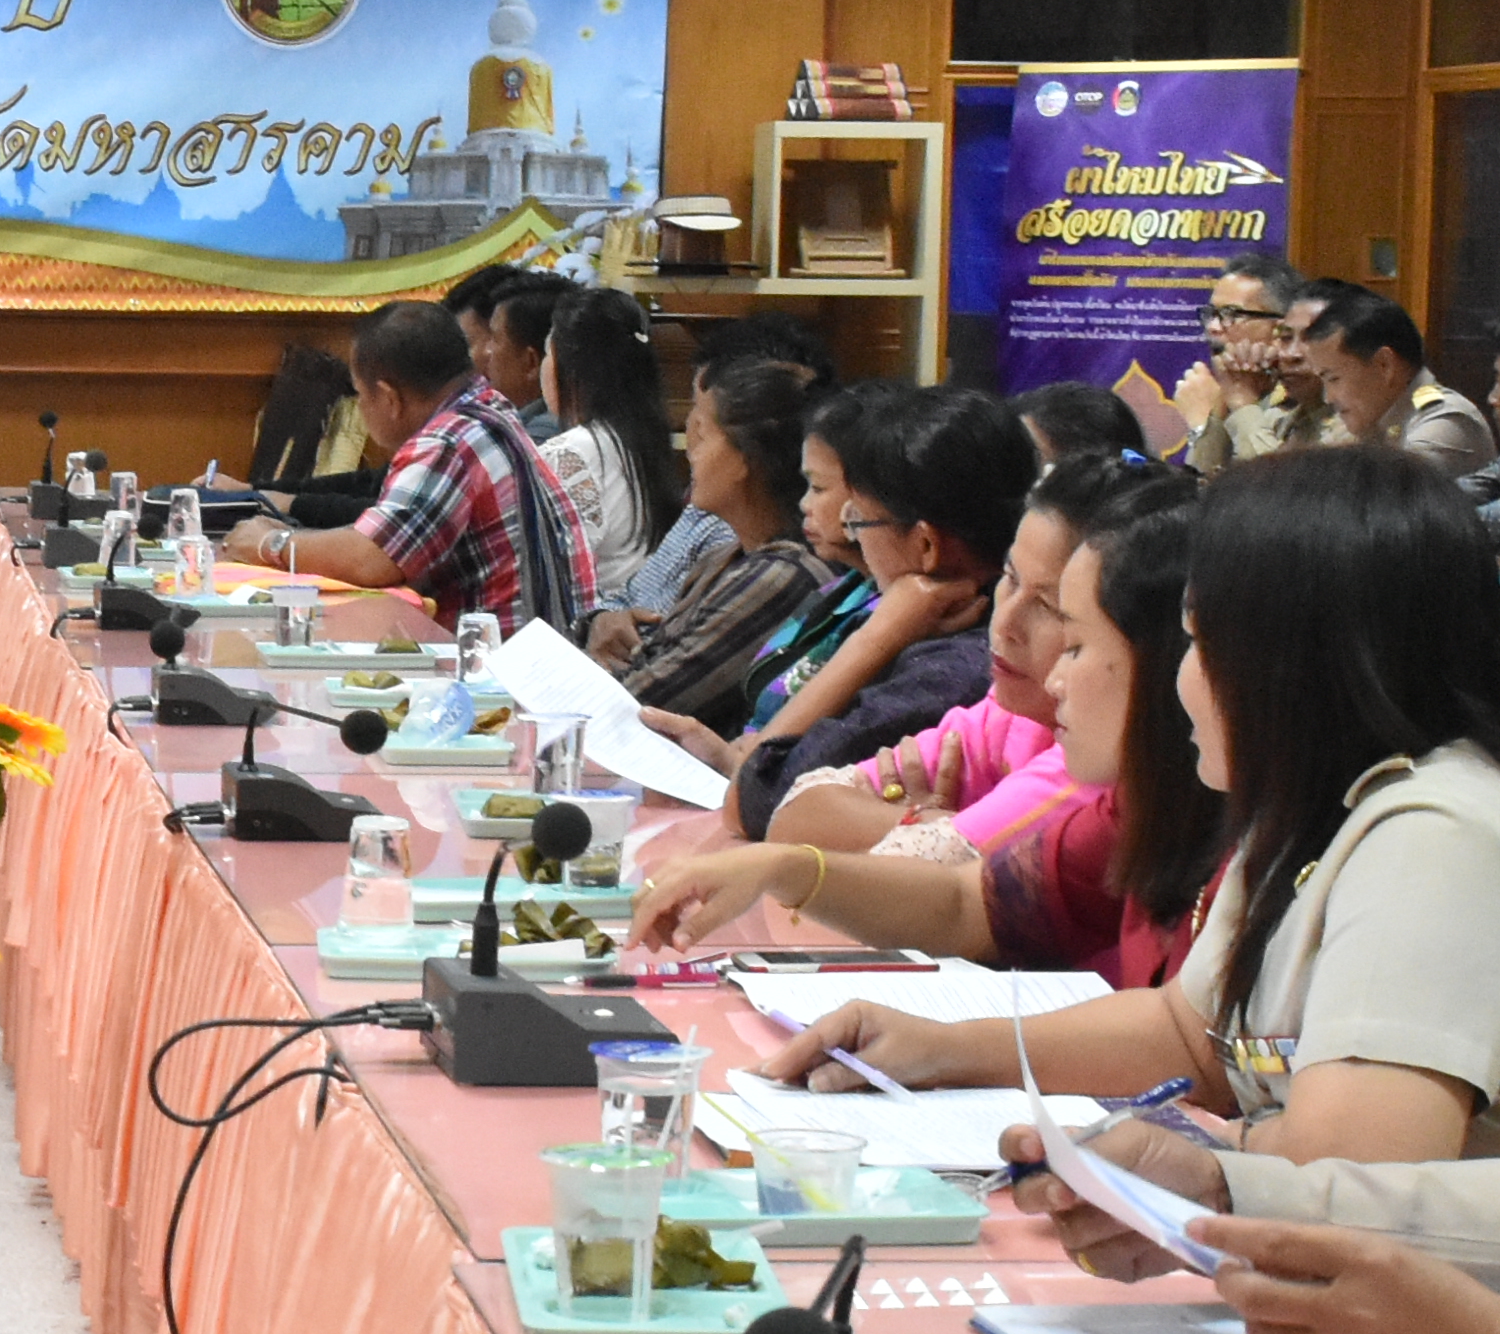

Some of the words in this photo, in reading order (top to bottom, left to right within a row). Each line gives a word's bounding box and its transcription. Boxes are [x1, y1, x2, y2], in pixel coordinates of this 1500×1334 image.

[1064, 144, 1231, 196] ผ้าไหมไทย
[1015, 197, 1266, 247] สร้อยดอกหมาก
